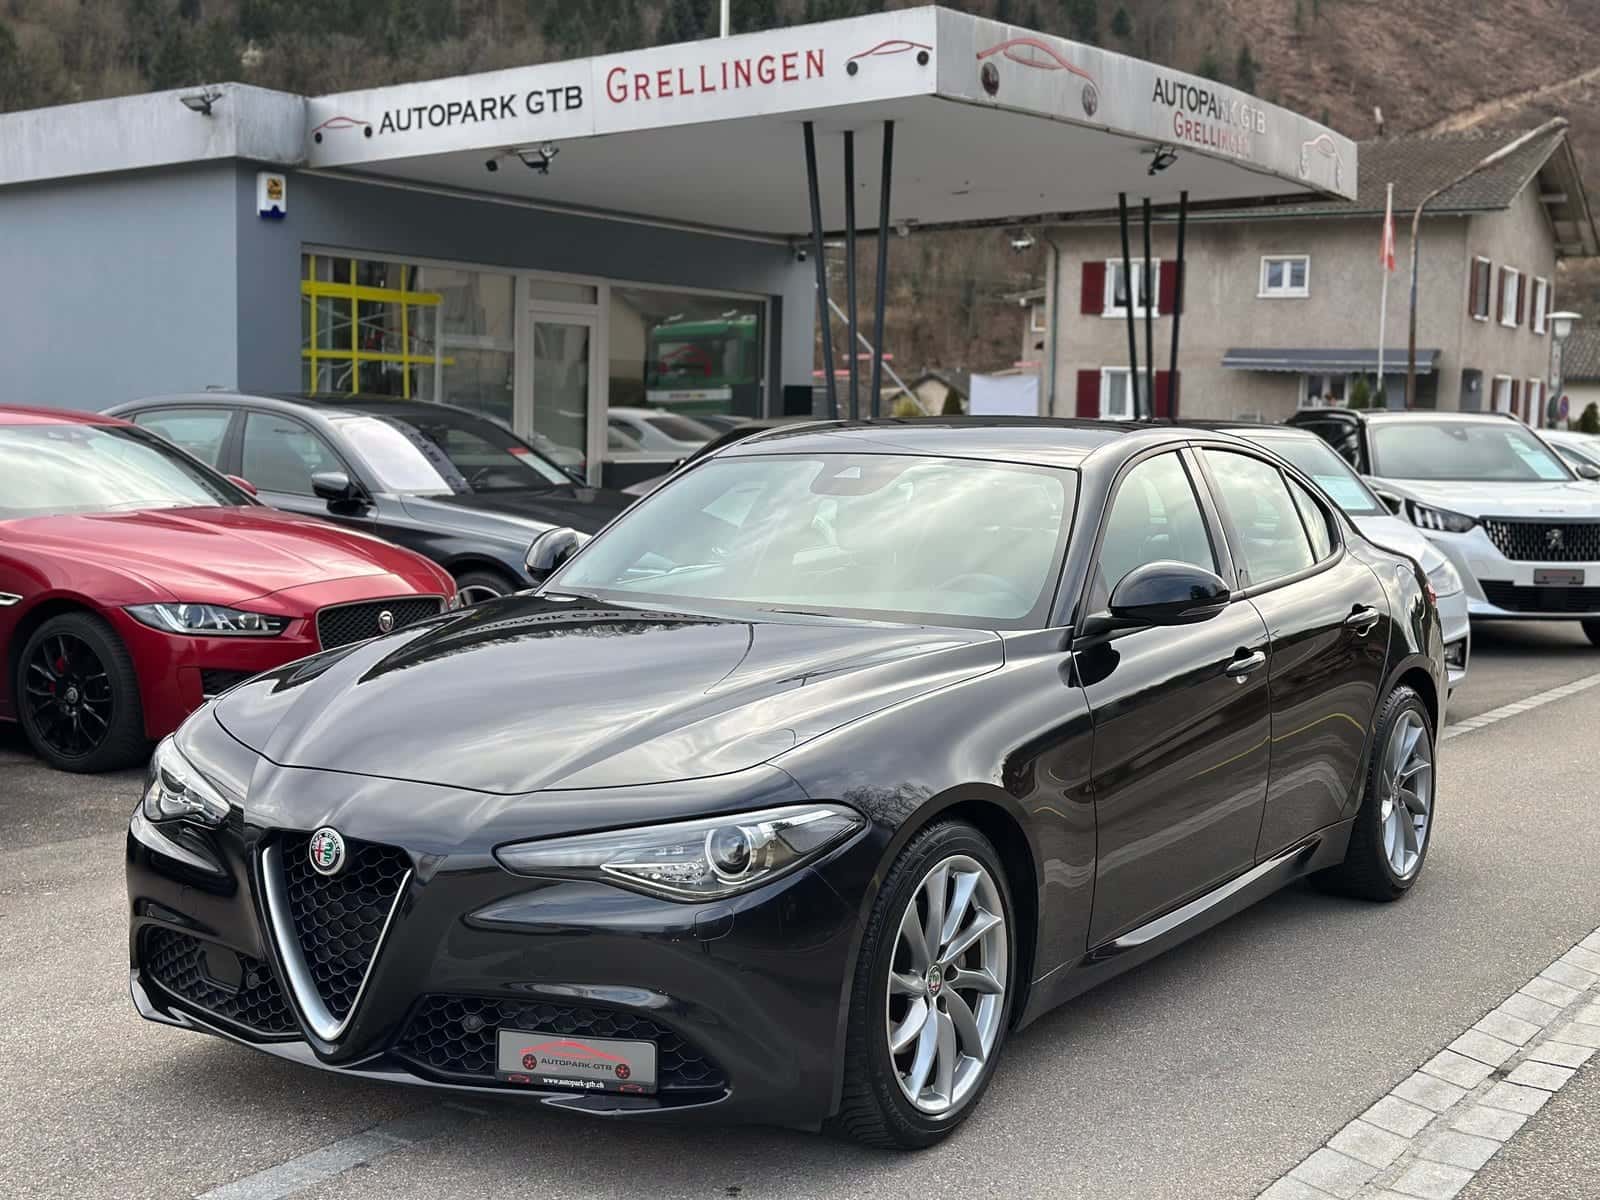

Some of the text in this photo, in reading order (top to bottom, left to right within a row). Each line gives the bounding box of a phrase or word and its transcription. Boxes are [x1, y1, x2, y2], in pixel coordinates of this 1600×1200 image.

[606, 49, 825, 103] GRELLINGEN
[379, 85, 583, 134] AUTOPARK GTB
